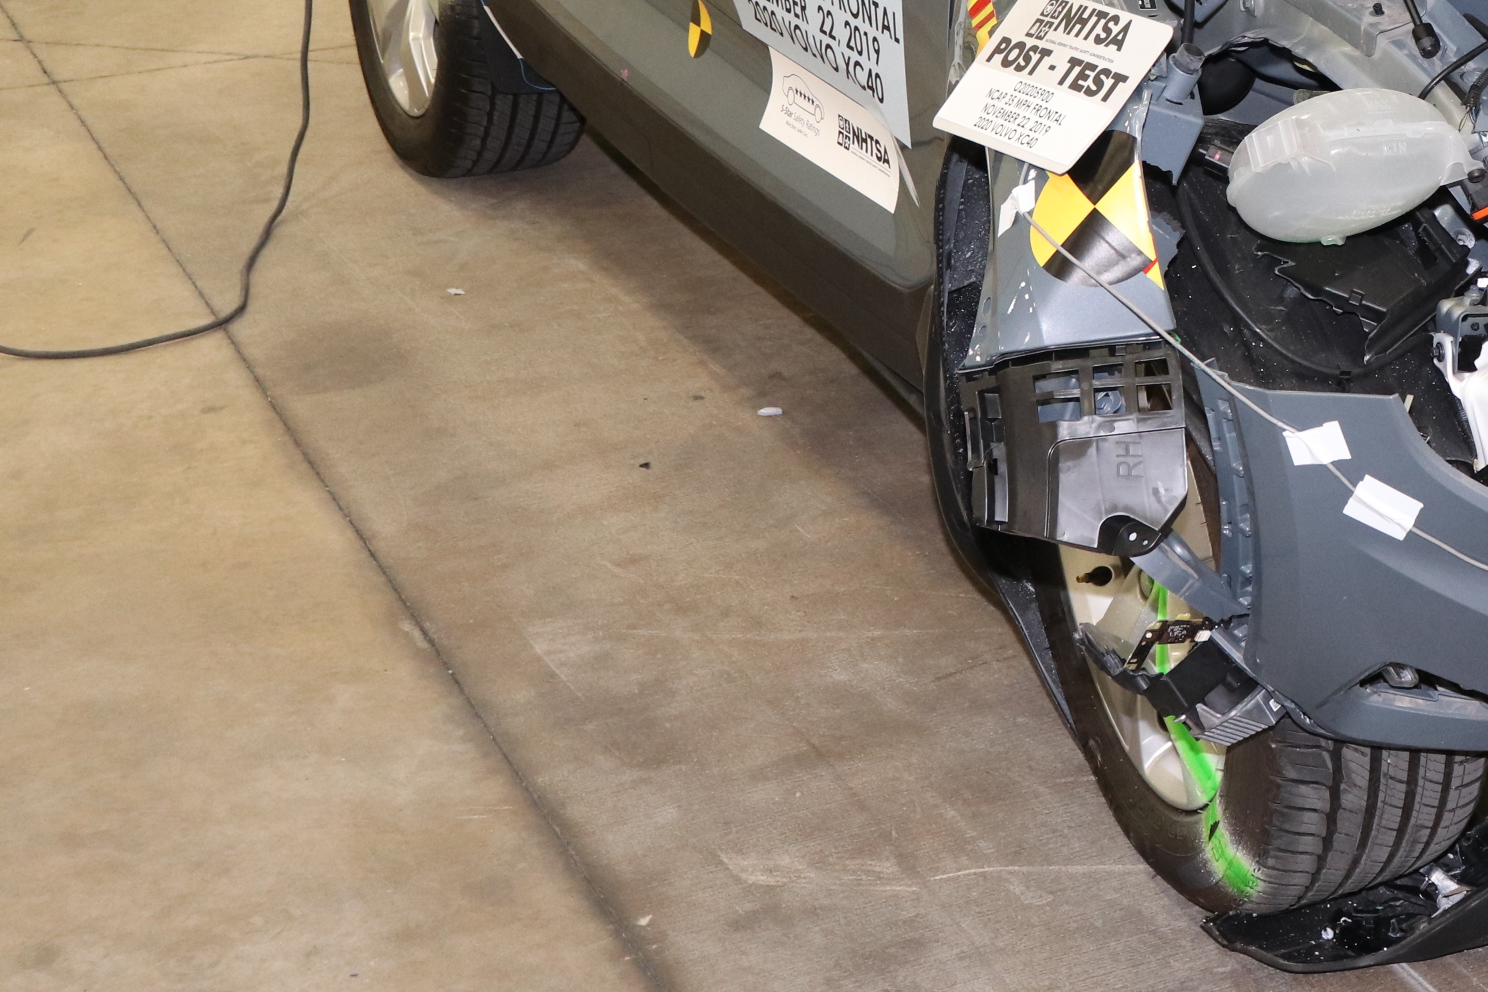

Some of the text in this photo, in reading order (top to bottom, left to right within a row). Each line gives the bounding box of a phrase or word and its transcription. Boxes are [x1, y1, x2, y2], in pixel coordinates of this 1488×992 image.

[817, 5, 841, 47] 22,
[844, 20, 881, 66] 2019
[1053, 2, 1133, 52] NHTSA
[781, 16, 840, 73] VOLVO
[841, 51, 885, 104] XC40
[985, 36, 1054, 76] POST
[1057, 56, 1130, 103] TEST
[981, 102, 1052, 136] NOVEMBER 22, 2019
[986, 87, 1067, 126] NCAP 35 MPH FRONTAL
[851, 123, 891, 169] NHTSA
[973, 116, 1039, 149] 2020 VOLVO XC40
[1115, 441, 1144, 478] RH
